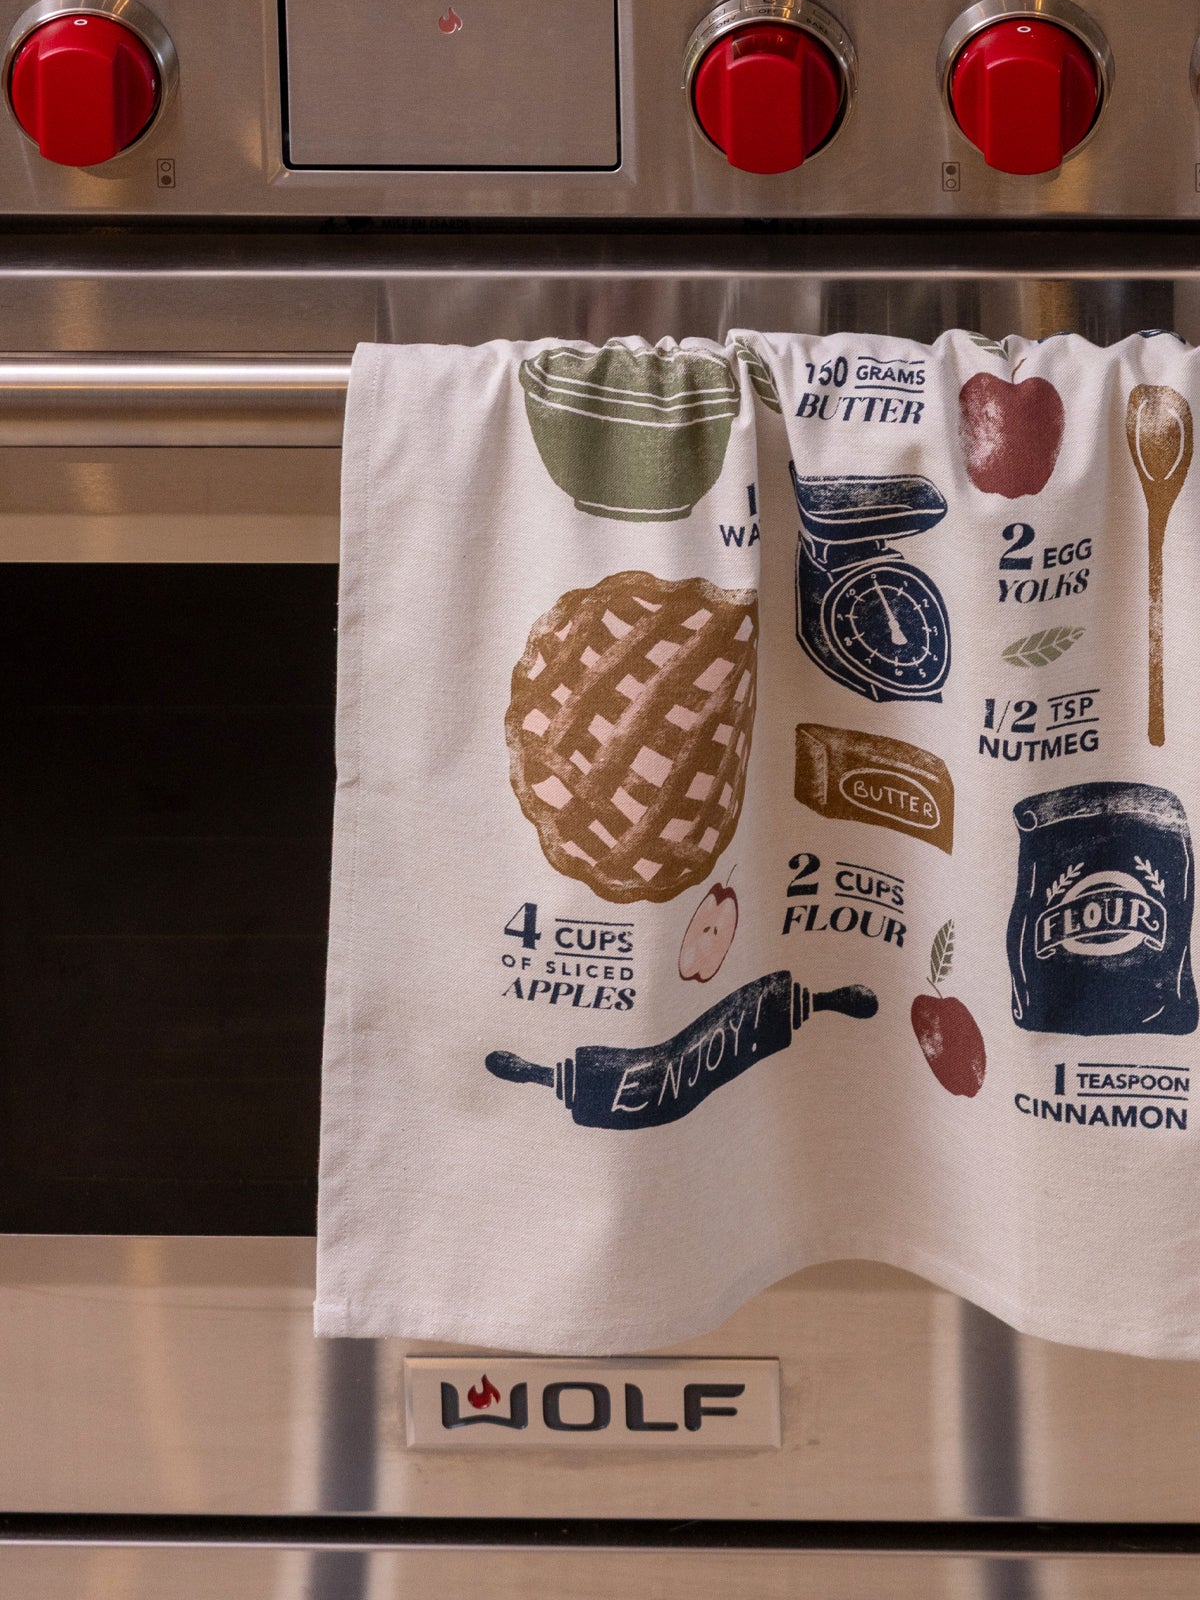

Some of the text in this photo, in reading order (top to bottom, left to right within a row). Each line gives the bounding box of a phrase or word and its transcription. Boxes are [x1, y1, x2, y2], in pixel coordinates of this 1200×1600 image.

[856, 365, 926, 386] GRAMS
[795, 392, 925, 425] BUTTER
[999, 522, 1093, 571] 2 EGG
[998, 567, 1091, 604] YOLKS
[983, 697, 1094, 734] 1/2 TSP
[978, 729, 1100, 762] NUTMEG
[852, 780, 935, 819] BUTTER
[786, 853, 905, 907] 2 CUPS
[503, 902, 634, 954] 4 CUPS
[781, 904, 908, 948] FLOUR
[1042, 897, 1160, 943] FLOUR
[501, 953, 635, 982] OF SLICED
[501, 976, 637, 1012] APPLES
[610, 992, 768, 1114] ENJOY!
[1054, 1062, 1190, 1096] 1 TEASPOON
[1014, 1092, 1189, 1131] CINNAMON
[440, 1380, 746, 1433] WOLF
